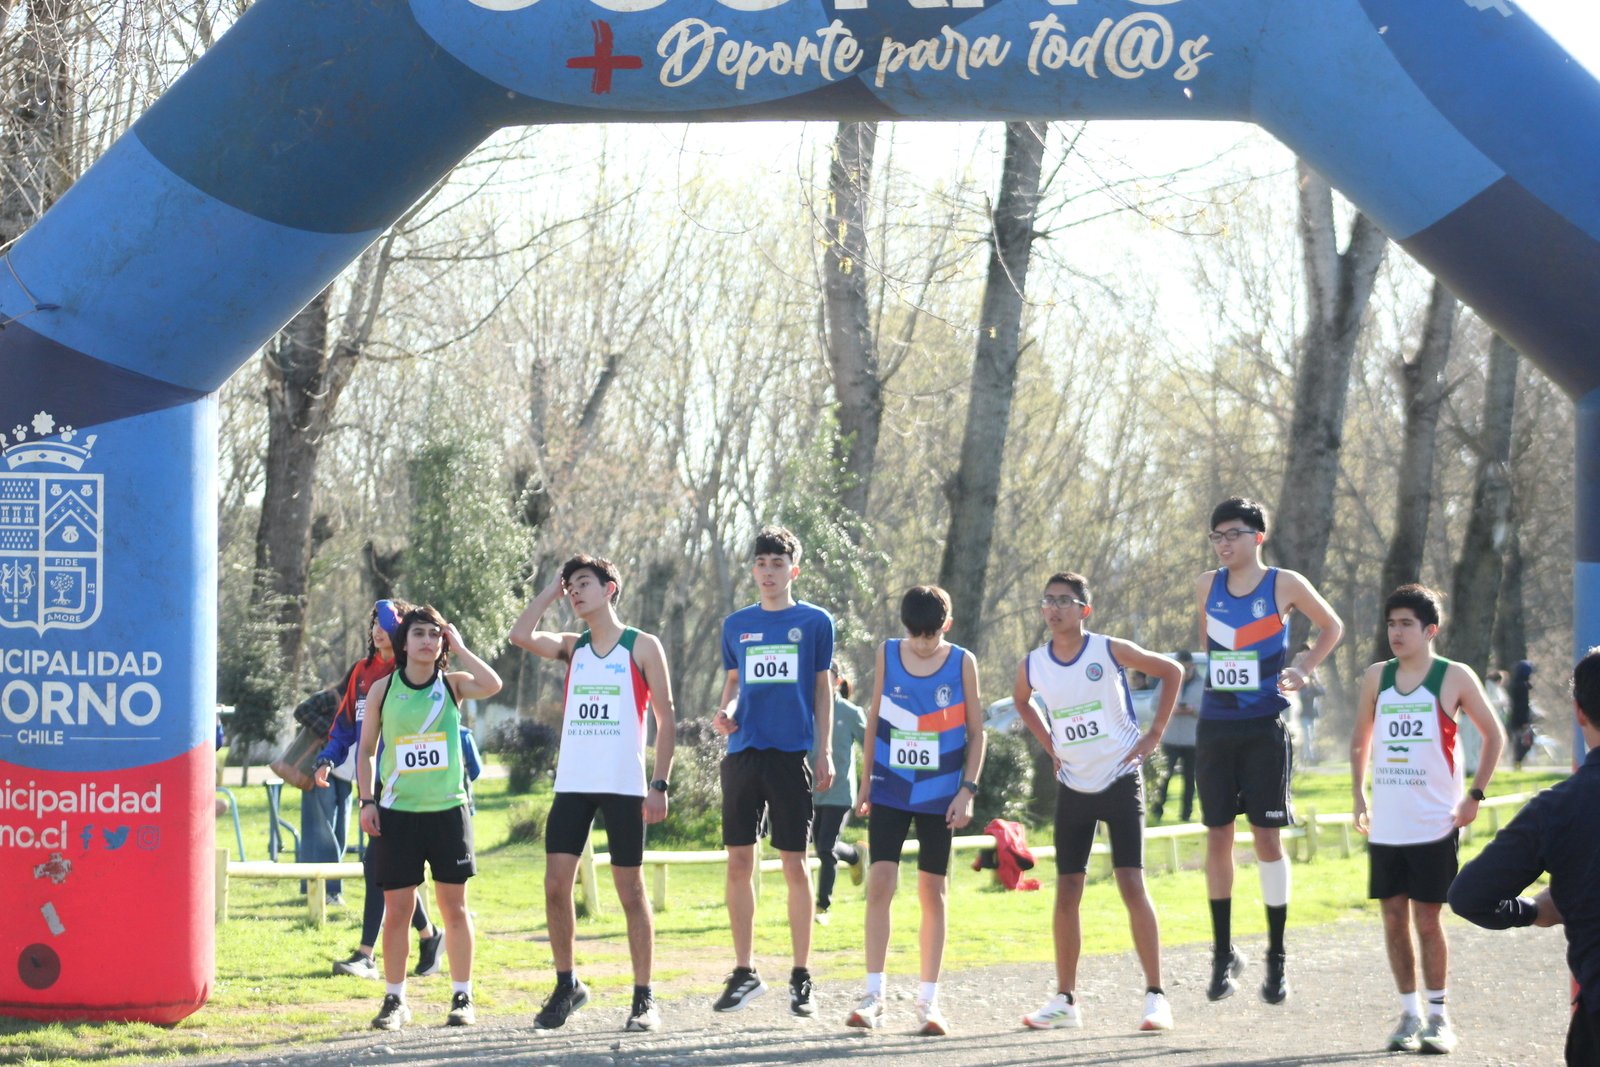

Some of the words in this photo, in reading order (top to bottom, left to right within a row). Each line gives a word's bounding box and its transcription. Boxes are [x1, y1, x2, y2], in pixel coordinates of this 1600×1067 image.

[656, 17, 864, 91] Deporte
[875, 25, 1011, 88] para
[1028, 11, 1214, 81] tod@s
[55, 558, 79, 566] FIDE
[87, 583, 96, 595] ET
[47, 613, 81, 623] AMORE
[754, 661, 789, 678] 004
[1216, 668, 1250, 685] 005
[579, 703, 610, 719] 001
[1065, 720, 1099, 741] 003
[1388, 720, 1423, 737] 002
[17, 729, 64, 745] CHILE
[404, 748, 441, 768] 050
[897, 749, 930, 765] 006
